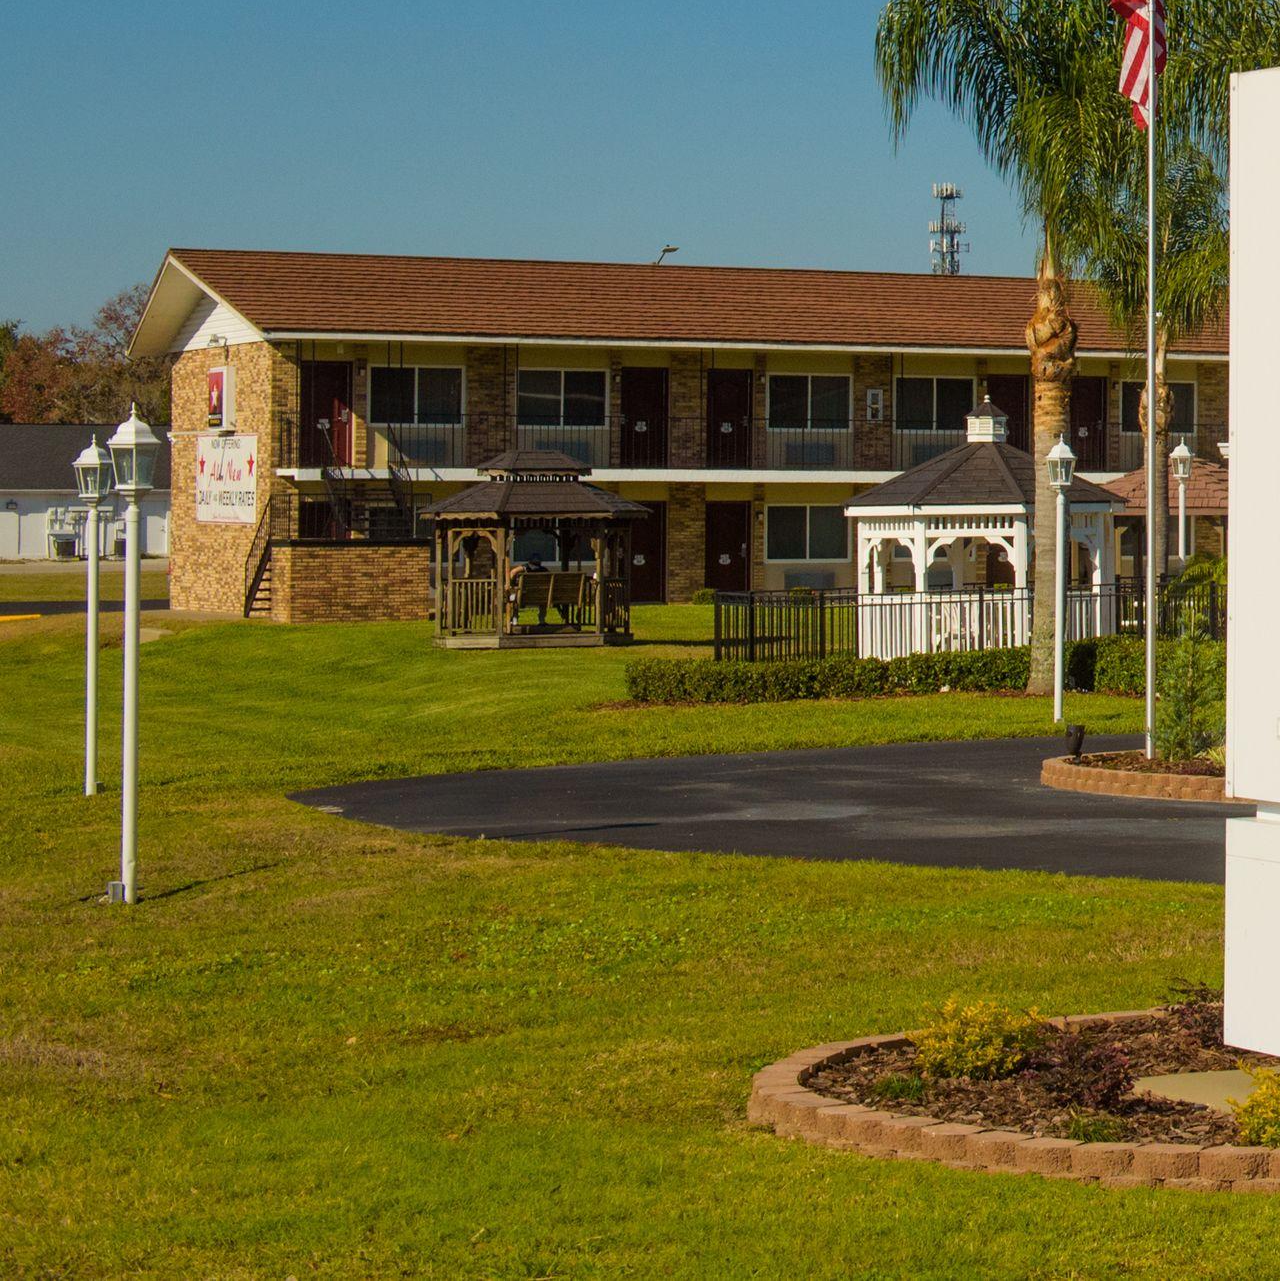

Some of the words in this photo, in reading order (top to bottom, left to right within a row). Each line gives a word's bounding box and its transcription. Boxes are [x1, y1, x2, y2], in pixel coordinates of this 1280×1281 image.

[198, 490, 212, 506] DAILY
[218, 490, 238, 506] WEEKLY
[238, 490, 255, 507] RATES
